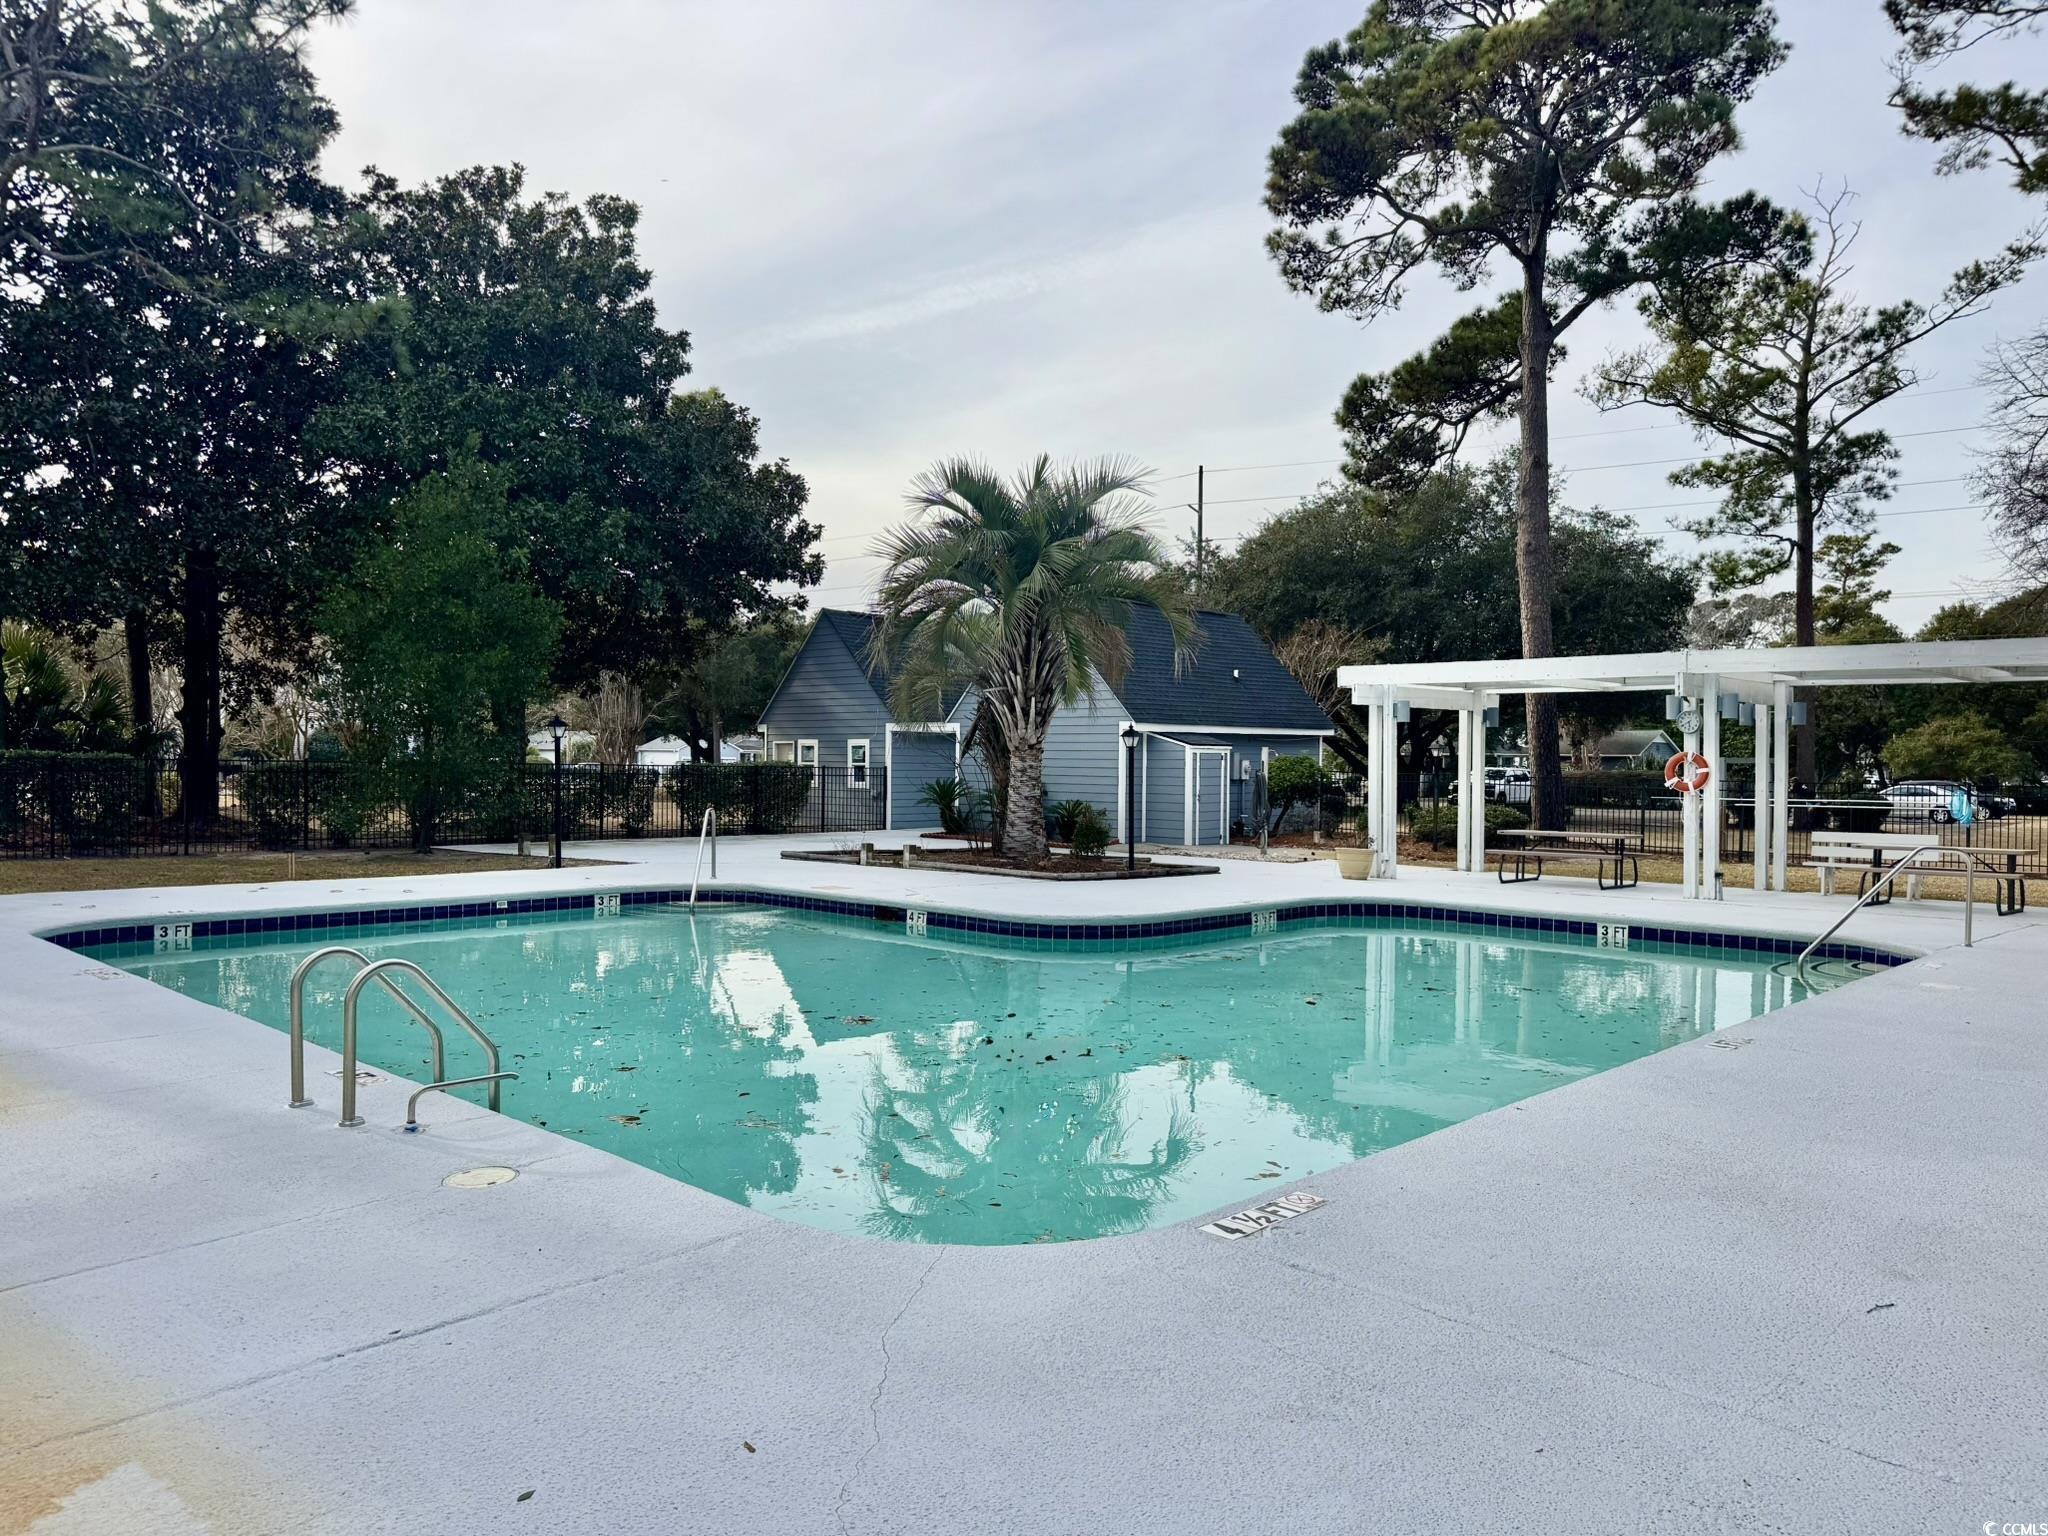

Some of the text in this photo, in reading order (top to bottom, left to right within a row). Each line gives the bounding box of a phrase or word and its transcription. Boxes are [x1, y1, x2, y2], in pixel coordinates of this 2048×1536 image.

[598, 895, 619, 907] 3 FT
[908, 911, 926, 924] 4 FT
[1253, 913, 1259, 924] 3
[160, 925, 191, 938] 3 FT
[1601, 925, 1627, 938] 3 FT
[1211, 1222, 1247, 1235] 4
[1254, 1201, 1302, 1219] FT
